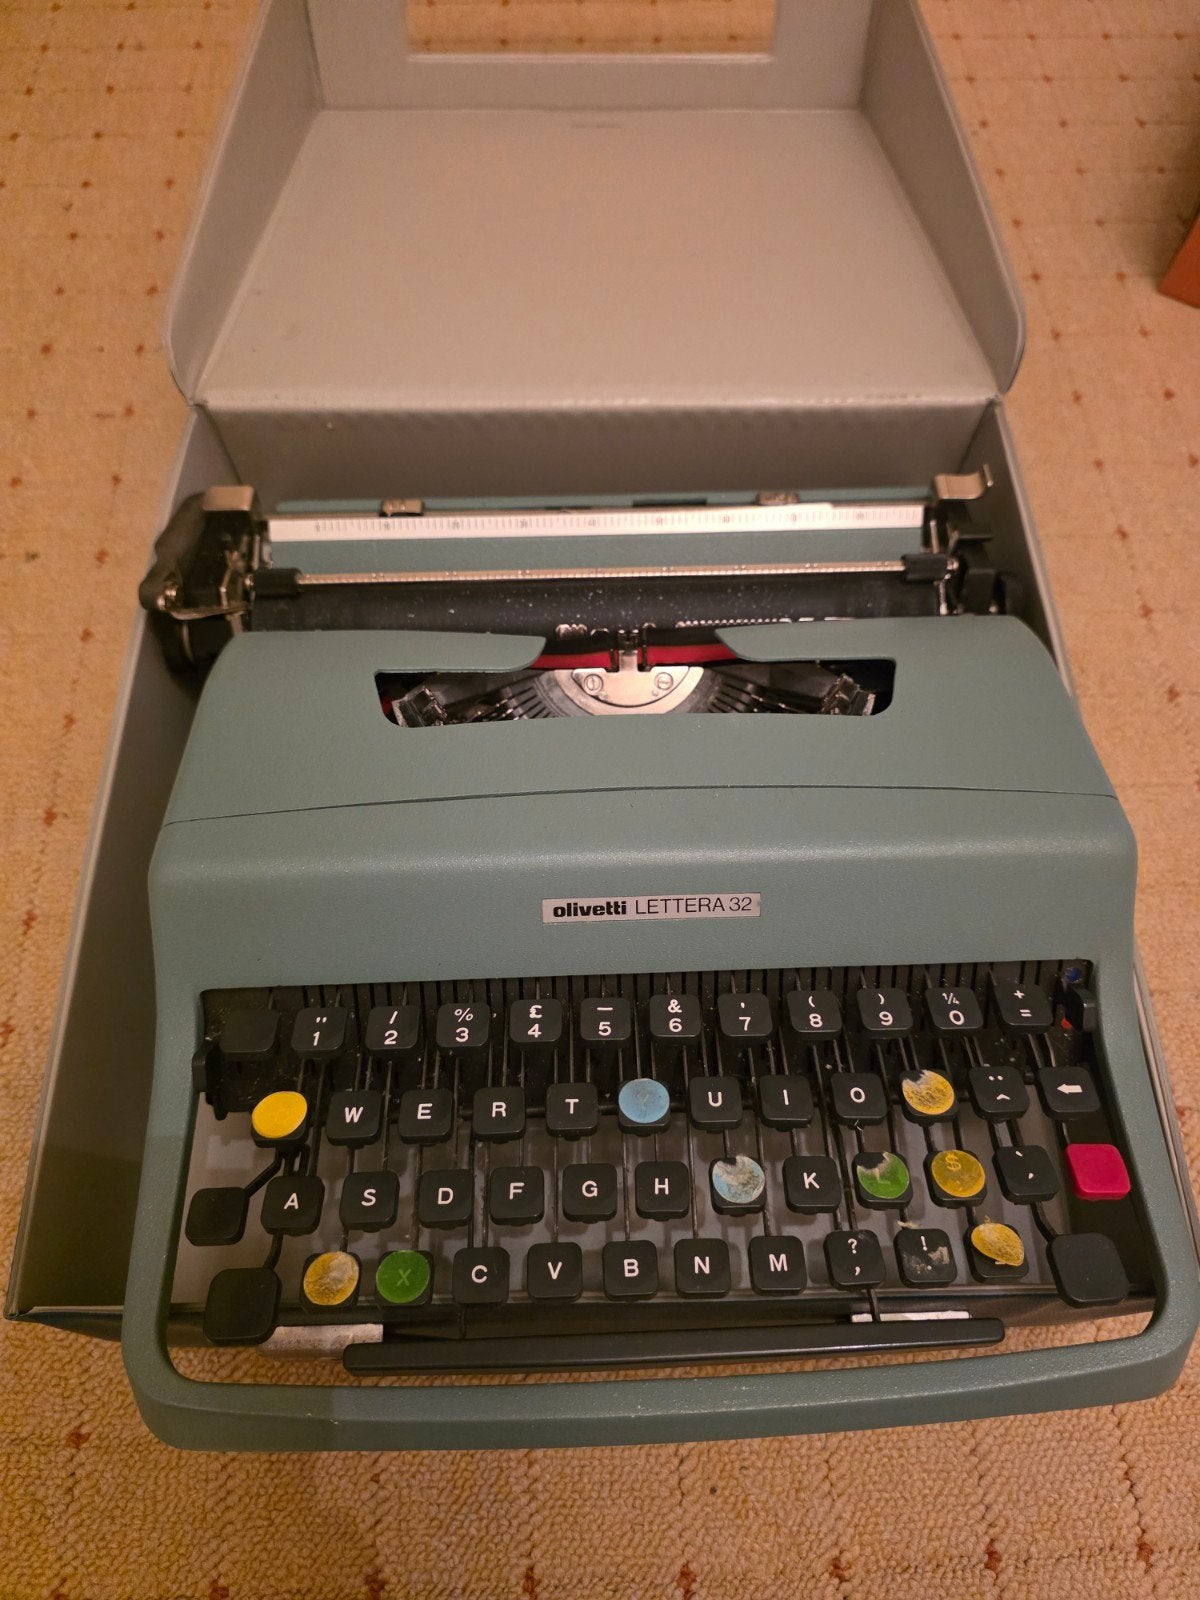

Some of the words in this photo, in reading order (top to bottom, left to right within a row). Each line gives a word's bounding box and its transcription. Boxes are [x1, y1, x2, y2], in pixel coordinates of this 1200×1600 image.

[553, 901, 627, 918] olivetti
[635, 897, 725, 915] LETTERA
[729, 896, 752, 912] 32
[808, 995, 816, 1008] (
[877, 993, 885, 1006] )
[1013, 988, 1026, 999] +
[454, 1007, 475, 1022] %
[528, 1004, 543, 1019] £
[667, 998, 683, 1014] &
[1018, 1009, 1032, 1018] =
[668, 1017, 683, 1033] 6
[738, 1016, 752, 1032] 7
[808, 1013, 823, 1028] 8
[878, 1010, 893, 1026] 9
[383, 1029, 398, 1045] 2
[455, 1026, 469, 1043] 3
[527, 1023, 542, 1039] 4
[598, 1021, 612, 1037] 5
[313, 1030, 322, 1047] 1
[707, 1091, 723, 1107] U
[783, 1089, 790, 1106] I
[849, 1086, 866, 1104] O
[344, 1106, 364, 1123] W
[416, 1102, 433, 1120] E
[491, 1101, 507, 1118] R
[564, 1098, 580, 1115] T
[945, 1152, 962, 1172] $
[581, 1180, 598, 1198] G
[654, 1177, 669, 1195] H
[803, 1172, 820, 1189] K
[361, 1188, 377, 1207] S
[437, 1187, 454, 1205] D
[509, 1182, 525, 1200] F
[284, 1192, 300, 1210] A
[847, 1237, 858, 1255] ?
[920, 1235, 928, 1252] !
[547, 1261, 563, 1280] V
[623, 1258, 640, 1278] B
[694, 1255, 710, 1275] N
[768, 1253, 788, 1272] M
[396, 1268, 411, 1287] X
[471, 1264, 488, 1284] C
